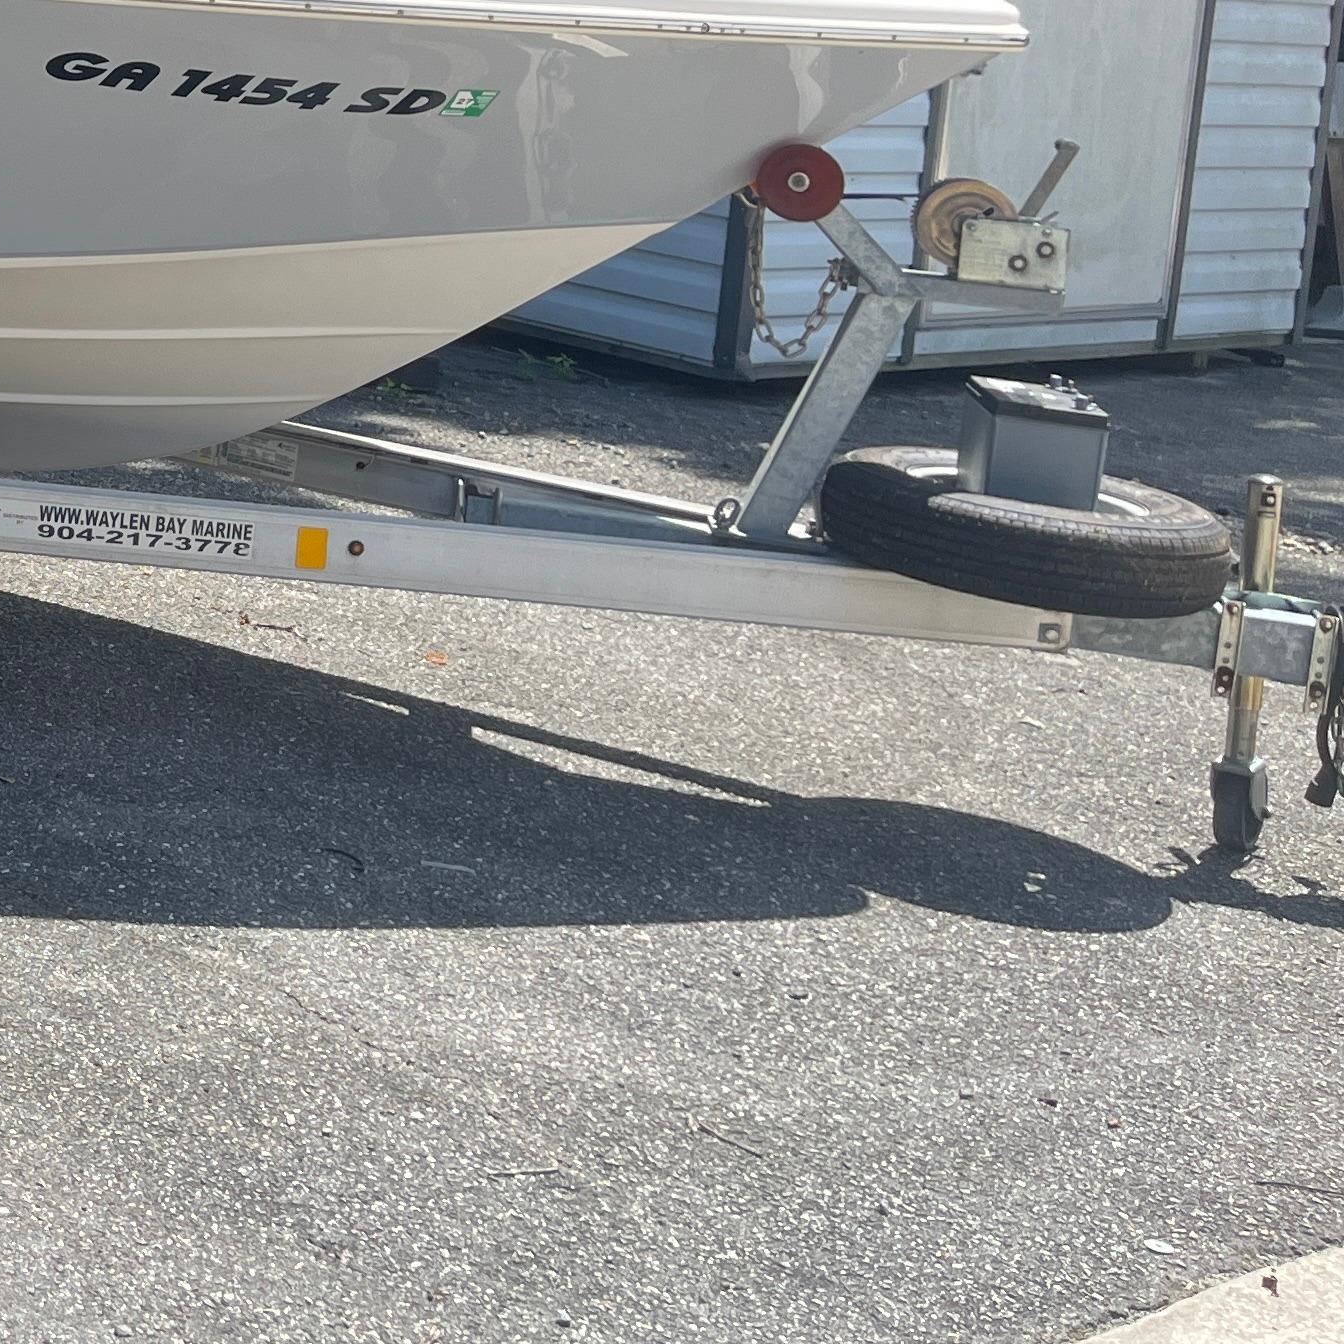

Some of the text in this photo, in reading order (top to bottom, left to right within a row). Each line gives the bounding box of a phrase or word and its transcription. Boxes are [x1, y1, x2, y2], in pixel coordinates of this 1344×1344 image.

[45, 51, 447, 115] GA 1454 SD
[39, 505, 254, 541] WWW.WAYLEN BAY MARINE
